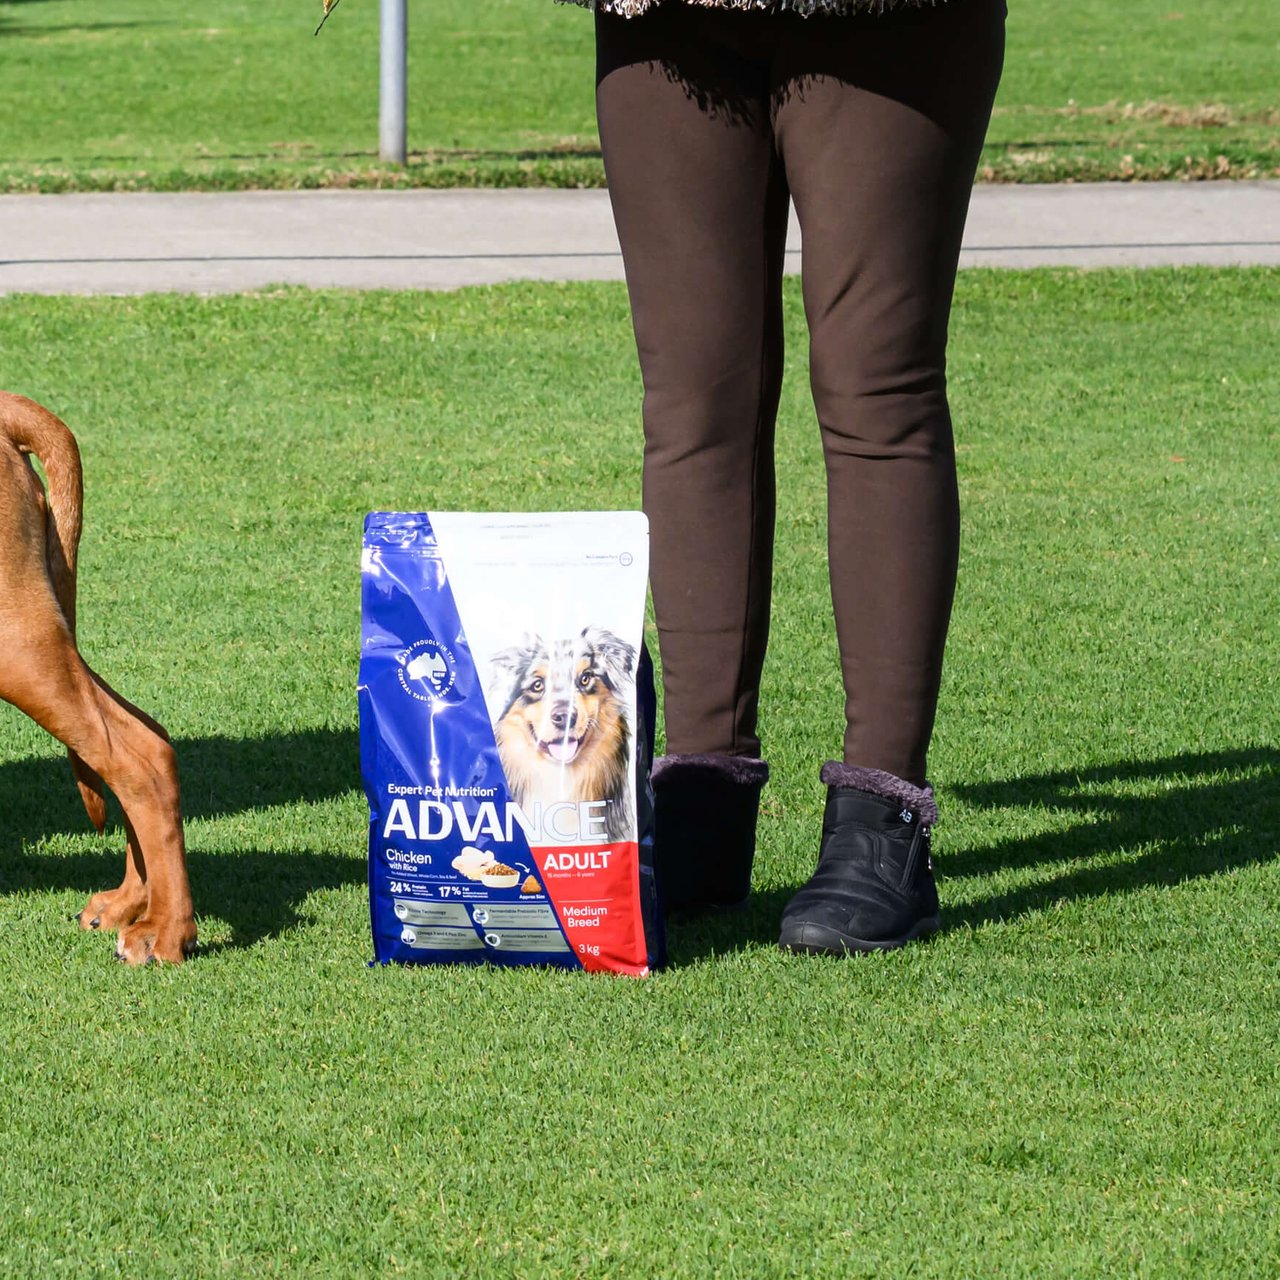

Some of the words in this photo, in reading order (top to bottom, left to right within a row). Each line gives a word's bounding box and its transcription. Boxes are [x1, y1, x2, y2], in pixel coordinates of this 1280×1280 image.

[387, 783, 422, 797] Expert
[425, 785, 443, 797] Pet
[444, 786, 495, 798] Nutrition
[382, 798, 609, 843] ADVANCE
[386, 848, 432, 865] Chicken
[543, 851, 612, 871] ADULT
[389, 862, 403, 871] with
[403, 863, 418, 873] Rice
[562, 905, 608, 917] Medium
[567, 916, 600, 928] Breed
[578, 944, 586, 954] 3
[587, 943, 600, 956] kg
